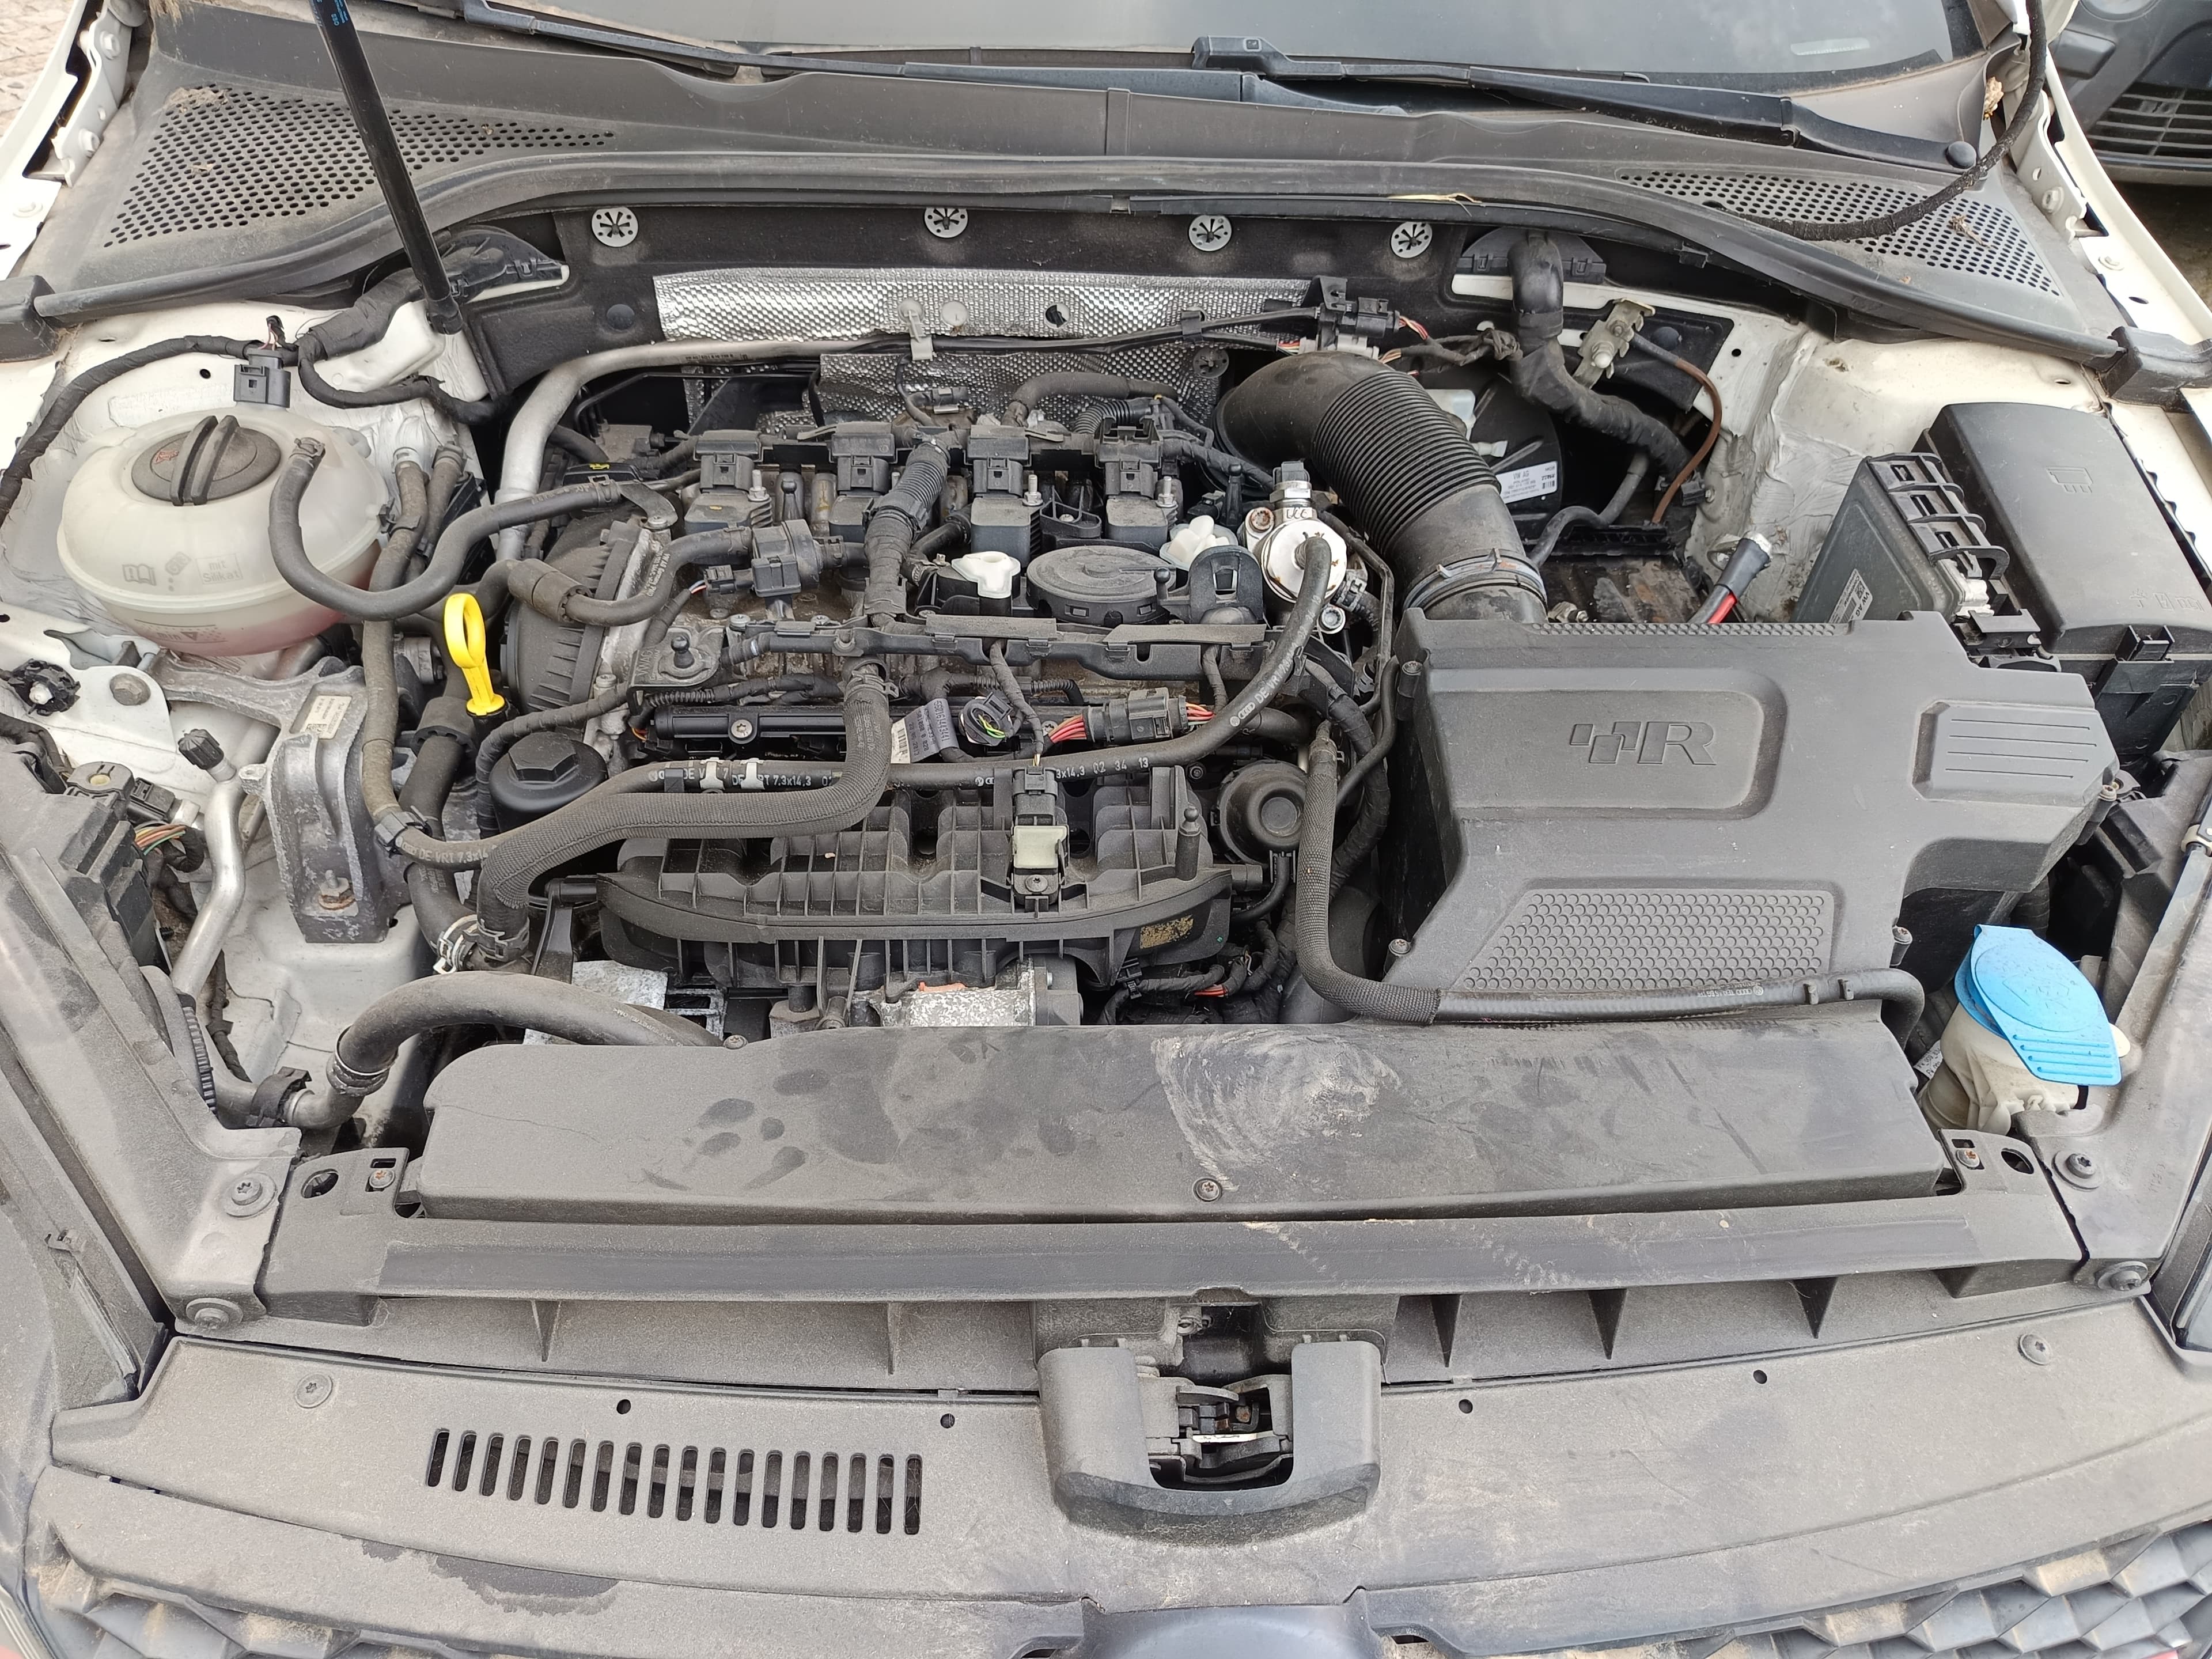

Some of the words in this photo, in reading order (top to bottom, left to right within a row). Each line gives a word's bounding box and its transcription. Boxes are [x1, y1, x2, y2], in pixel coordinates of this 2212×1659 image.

[209, 559, 226, 570] mit
[202, 570, 240, 582] Silikat
[1862, 592, 1870, 605] VW
[1855, 603, 1862, 617] AG
[1254, 687, 1270, 704] DE
[1055, 765, 1085, 779] 3x14.3
[1115, 759, 1127, 771] 34
[1138, 756, 1149, 768] 13
[419, 847, 432, 861] DE
[435, 851, 455, 863] VRT
